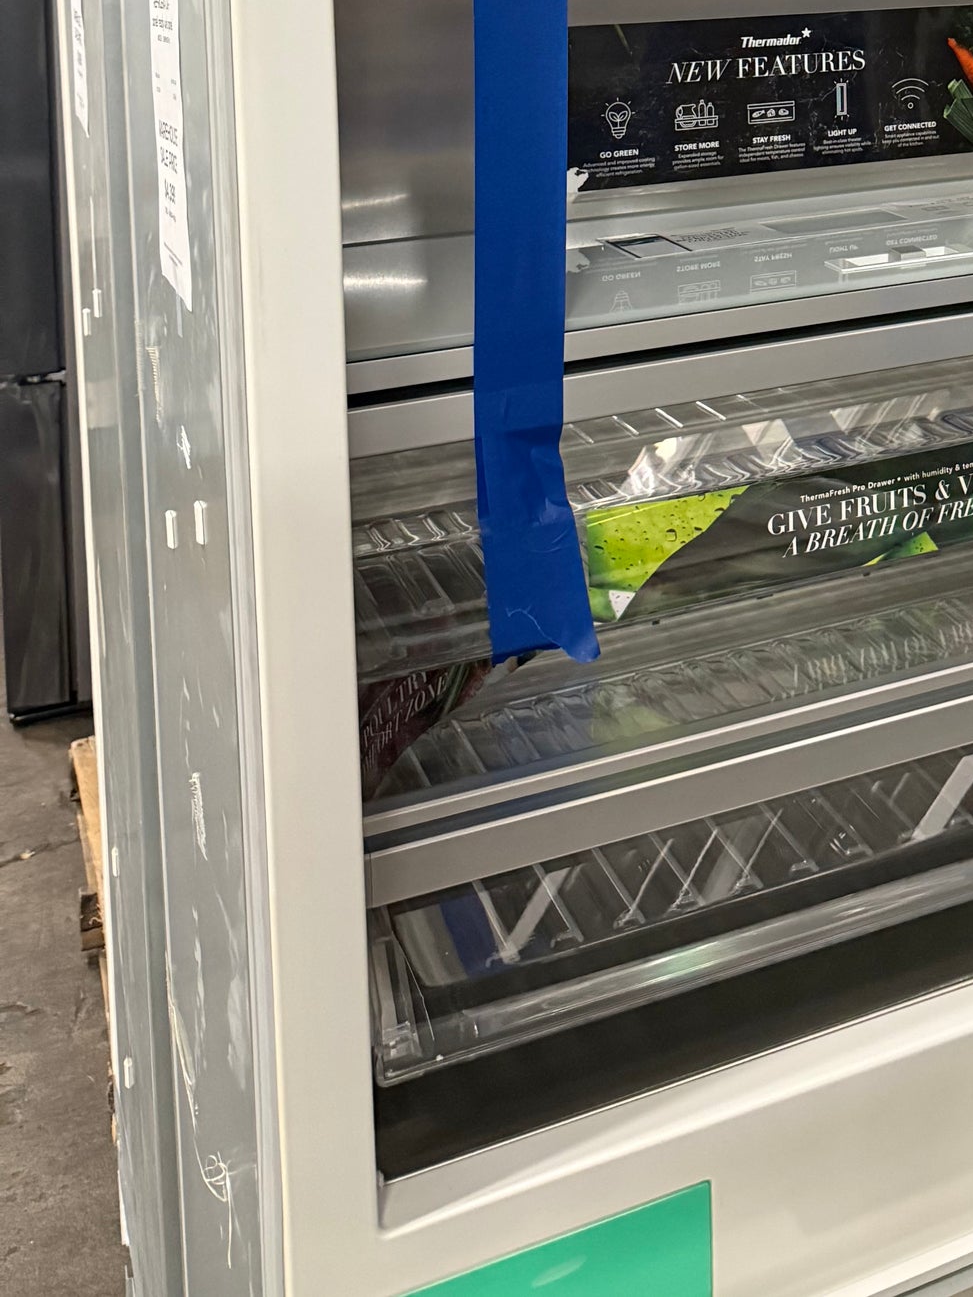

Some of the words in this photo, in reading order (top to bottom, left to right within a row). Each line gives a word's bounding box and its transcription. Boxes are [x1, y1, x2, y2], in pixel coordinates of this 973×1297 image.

[740, 34, 802, 48] Thermador
[665, 59, 732, 84] NEW
[736, 49, 866, 79] FEATURES
[827, 129, 847, 137] LIGHT
[848, 128, 858, 136] UP
[884, 124, 897, 132] GET
[897, 121, 937, 130] CONNECTED
[752, 136, 769, 144] STAY
[769, 134, 791, 142] FRESH
[674, 143, 698, 152] STORE
[698, 140, 720, 149] MORE
[599, 151, 612, 159] GO
[613, 149, 639, 158] GREEN
[800, 486, 850, 503] ThermaFresh
[852, 484, 866, 493] Pro
[868, 478, 896, 488] Drawer
[903, 471, 920, 482] with
[921, 466, 953, 478] humidity
[767, 503, 832, 536] GIVE
[839, 484, 927, 522] FRUITS
[935, 479, 950, 501] &
[782, 536, 798, 559] A
[804, 514, 900, 553] BREATH
[902, 506, 935, 531] OF
